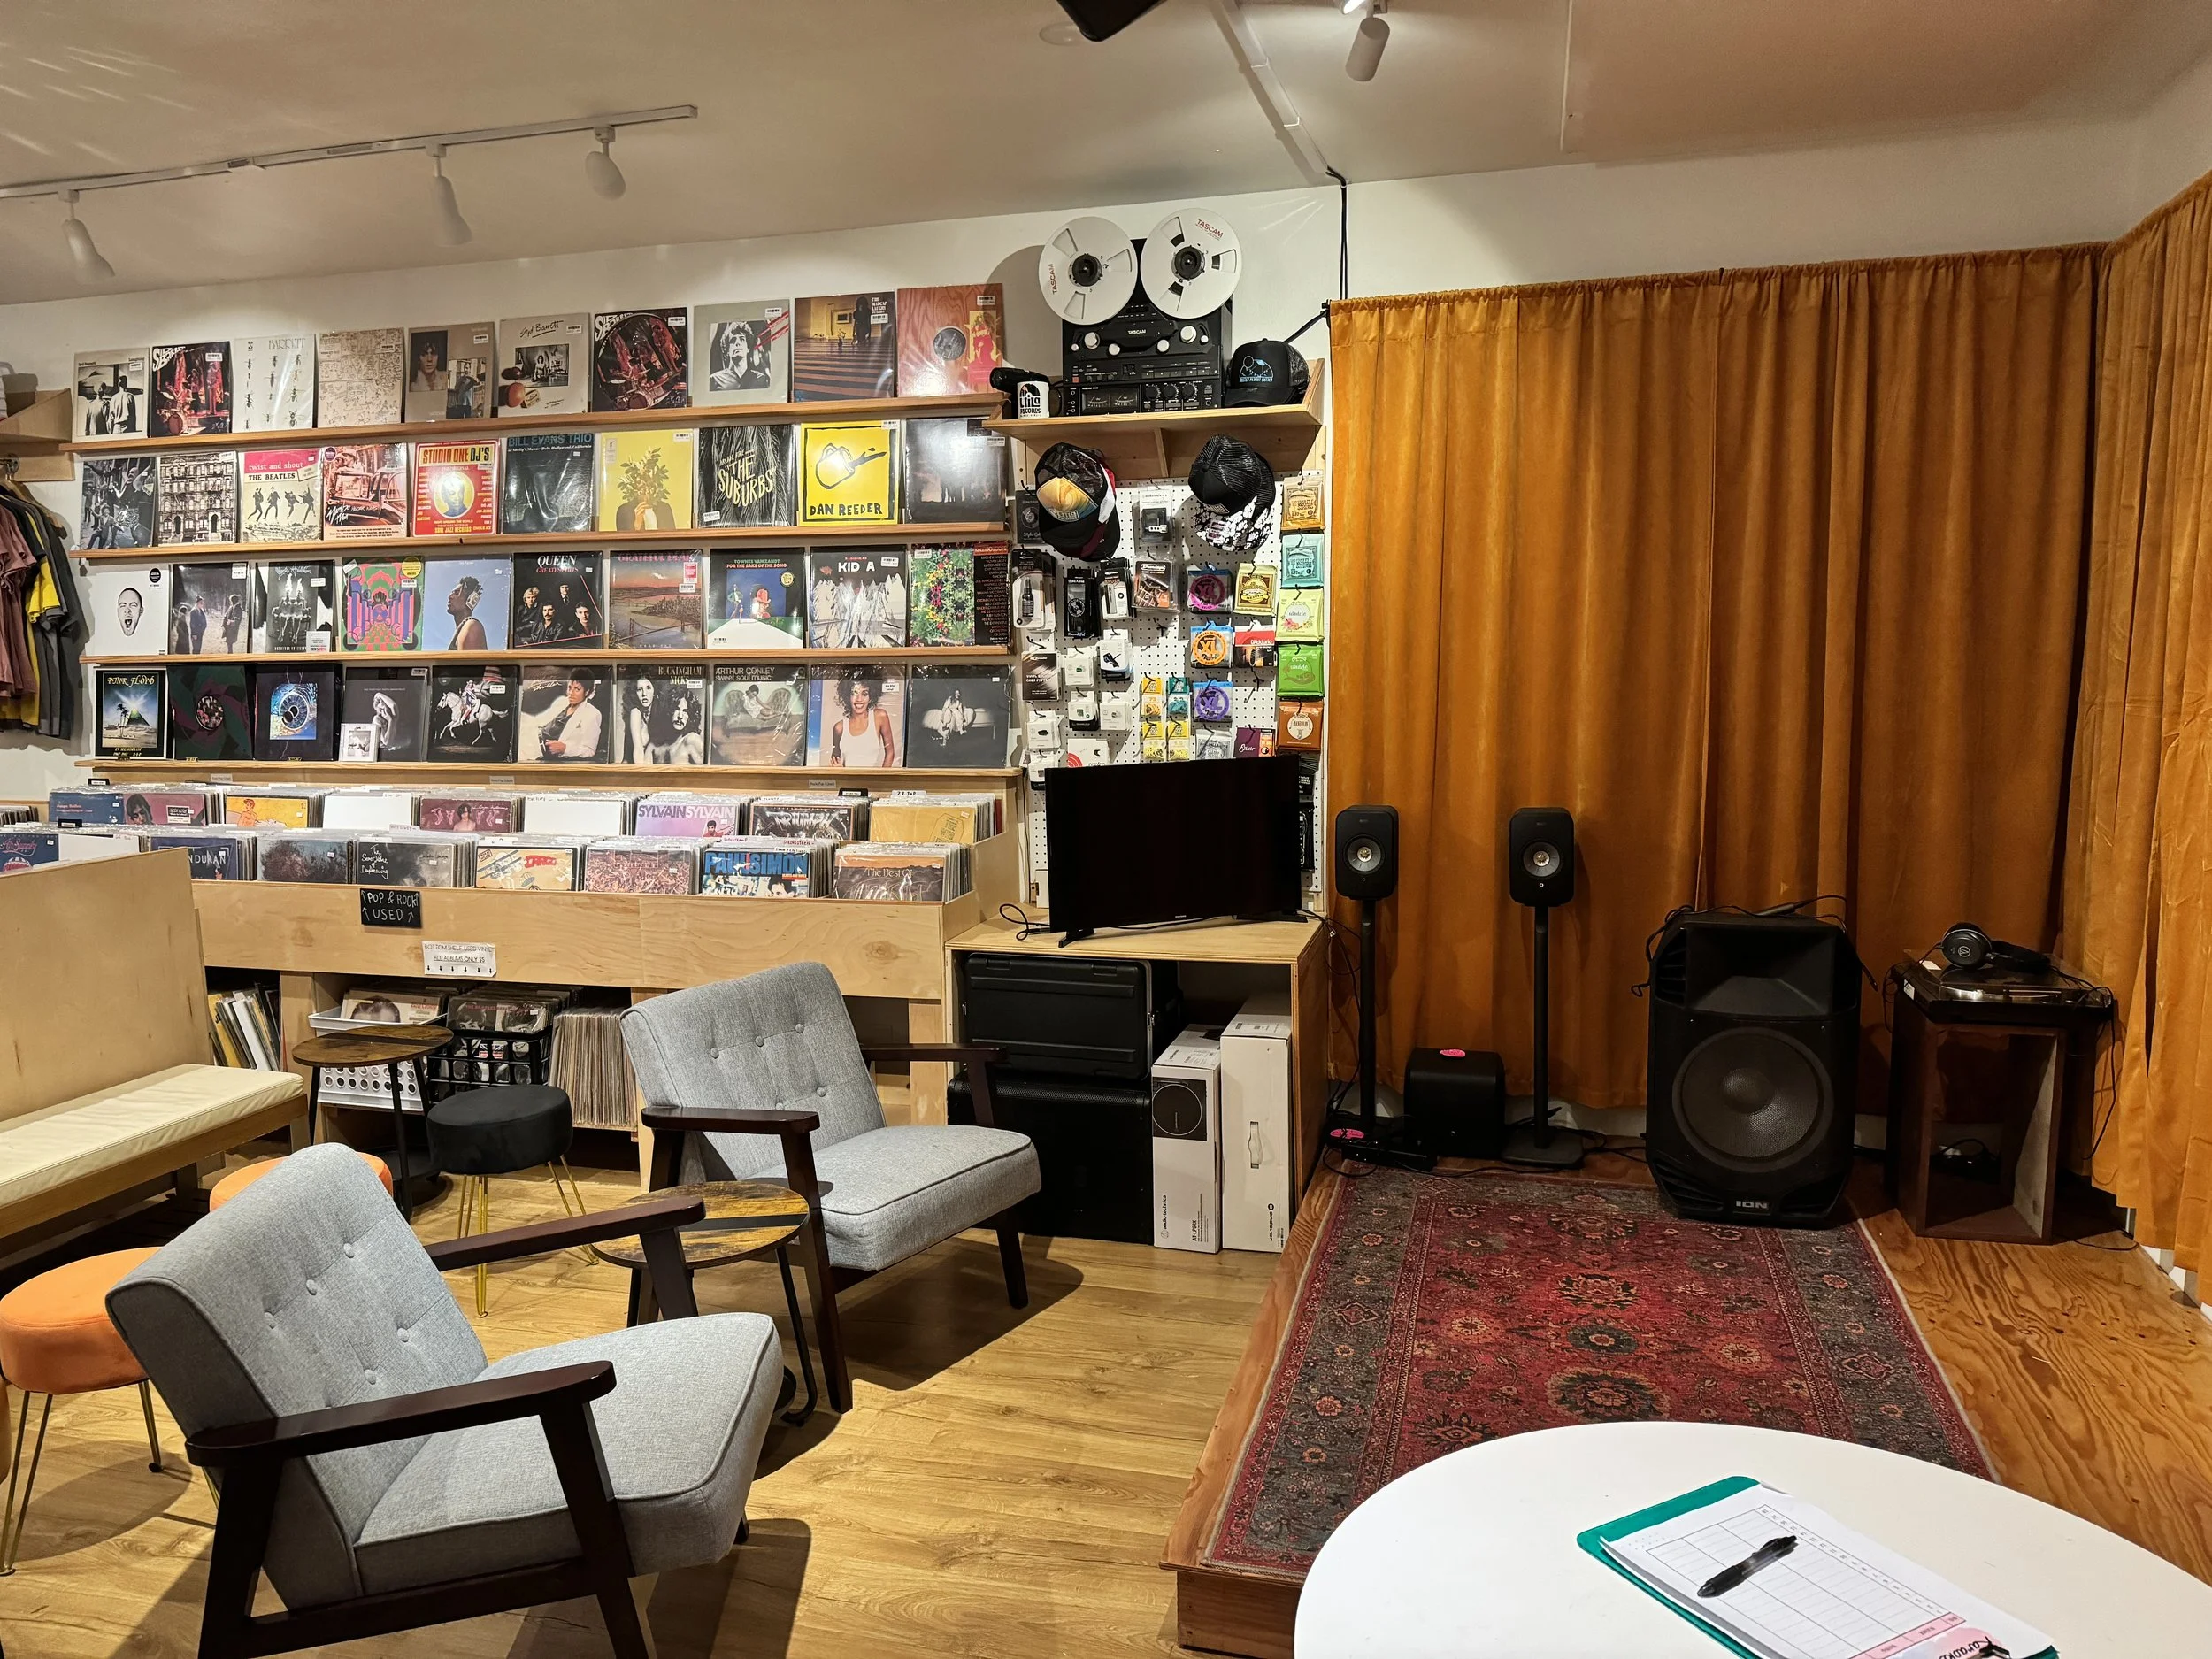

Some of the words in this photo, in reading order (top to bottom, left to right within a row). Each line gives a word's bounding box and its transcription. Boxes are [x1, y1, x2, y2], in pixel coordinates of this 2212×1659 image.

[1197, 219, 1225, 238] TASCAM
[1048, 263, 1058, 295] TASCAM
[268, 338, 306, 351] BARRETT
[508, 437, 529, 447] BILL
[531, 435, 565, 445] EVANS
[568, 434, 592, 443] TRIO
[422, 449, 452, 464] STUDIO
[453, 448, 469, 462] ONE
[470, 446, 489, 461] DJ'S
[810, 504, 833, 516] DAN
[838, 503, 883, 516] REEDER
[537, 555, 577, 567] QUEEN
[838, 562, 860, 572] KID
[866, 561, 875, 572] A
[1200, 641, 1218, 654] XL
[658, 665, 702, 676] BUCKINGHAM
[107, 677, 129, 686] PINK
[129, 674, 156, 687] FLOYD
[638, 805, 686, 818] SYLVAIN
[685, 806, 734, 818] SYLVAIN
[767, 811, 838, 826] TRIUMPH
[370, 844, 380, 855] The
[195, 855, 227, 864] DURAN
[704, 852, 749, 875] PAUL
[749, 851, 807, 875] SIMON
[864, 868, 881, 877] The
[367, 892, 385, 904] POP
[387, 890, 396, 904] &
[396, 894, 418, 908] ROCK
[373, 908, 403, 921] USED
[1736, 1200, 1767, 1209] ION
